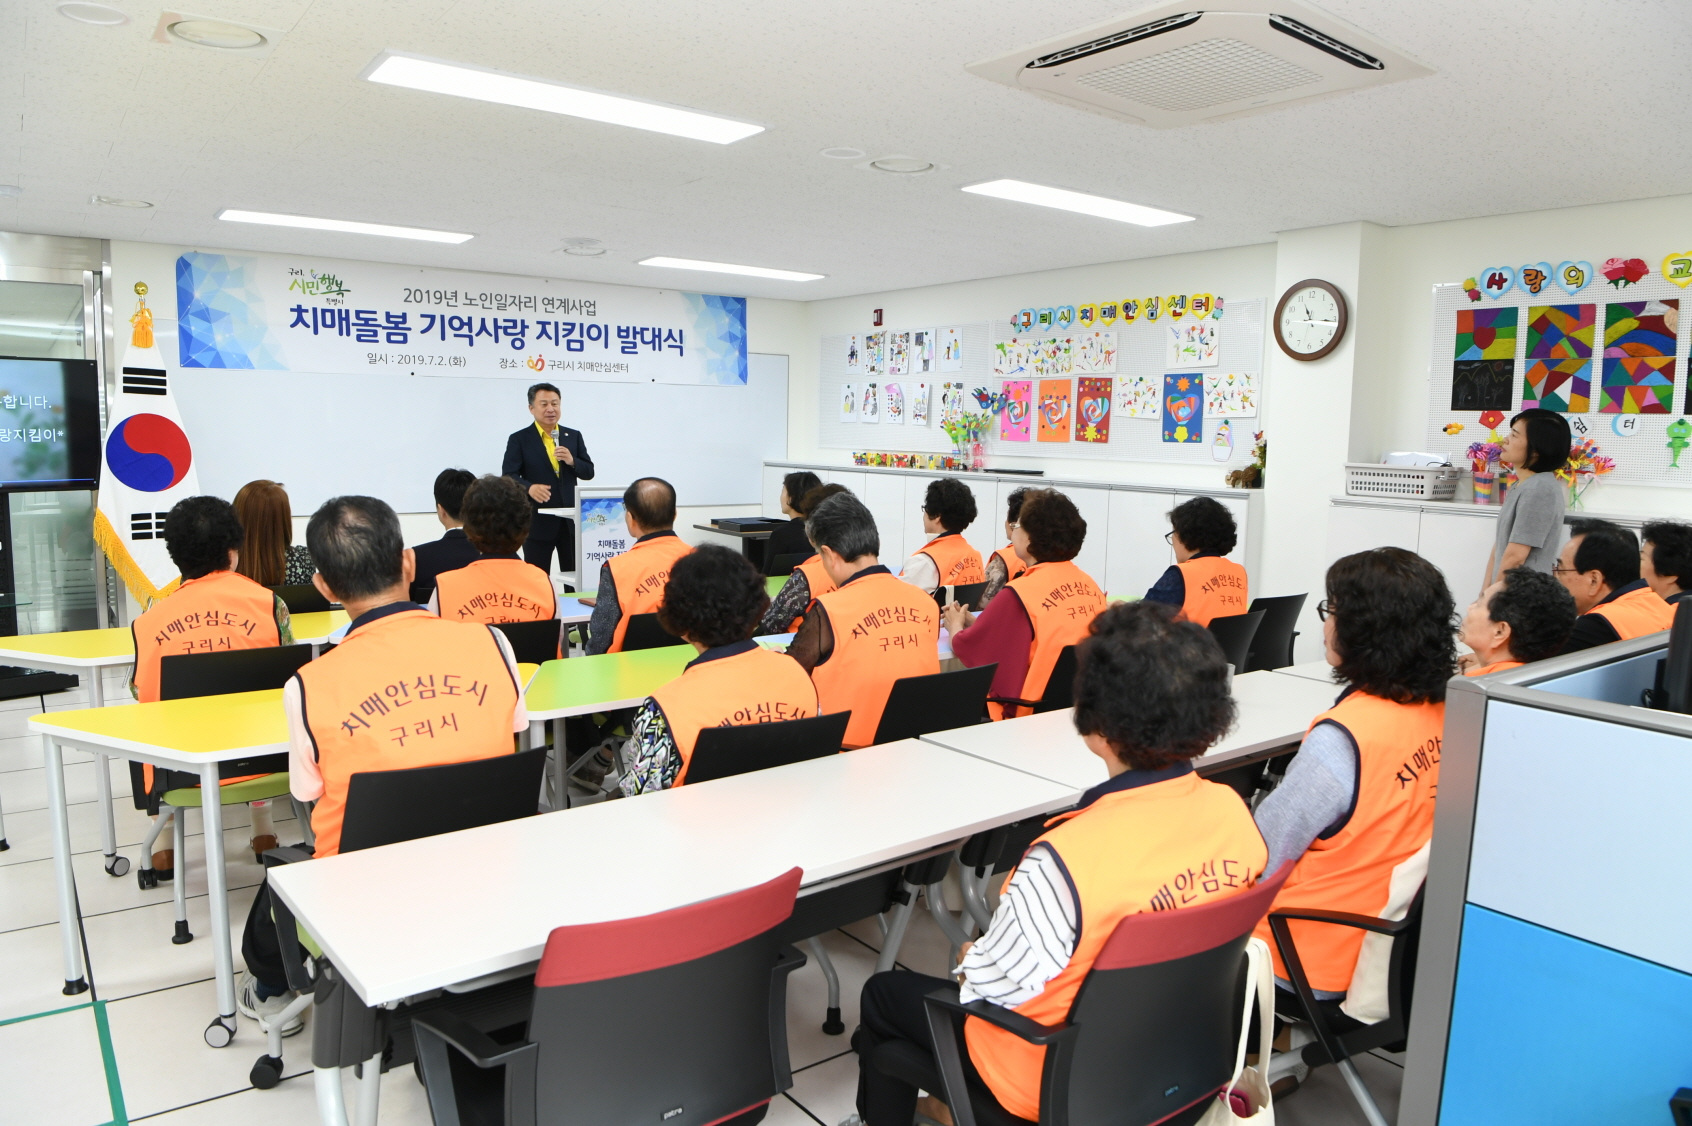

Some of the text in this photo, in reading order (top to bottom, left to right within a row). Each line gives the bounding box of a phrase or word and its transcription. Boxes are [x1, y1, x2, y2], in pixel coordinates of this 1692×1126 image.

[289, 273, 351, 298] 시민행복
[1487, 266, 1584, 293] 사랑의
[326, 297, 343, 305] 특별시
[403, 288, 596, 316] 2019년 노인일자리 연계사업
[1022, 295, 1210, 328] 구리시 치매안심센터
[290, 304, 684, 357] 치매돌봄 기억사랑 지킴이 발대식
[367, 353, 388, 365] 일시
[499, 358, 518, 369] 장소
[548, 359, 575, 371] 구리시
[577, 361, 629, 373] 치매안심센터
[0, 394, 52, 410] 합니다.
[598, 540, 625, 549] 치매돌봄
[1201, 574, 1245, 594] 치매안심도
[457, 592, 541, 619] 치매안심도시
[1220, 595, 1243, 606] 구리시
[154, 610, 256, 646] 치매안심도시
[182, 636, 231, 654] 구리시
[879, 633, 918, 652] 구리시
[341, 674, 488, 737] 치매안심도시
[389, 712, 458, 747] 구리시
